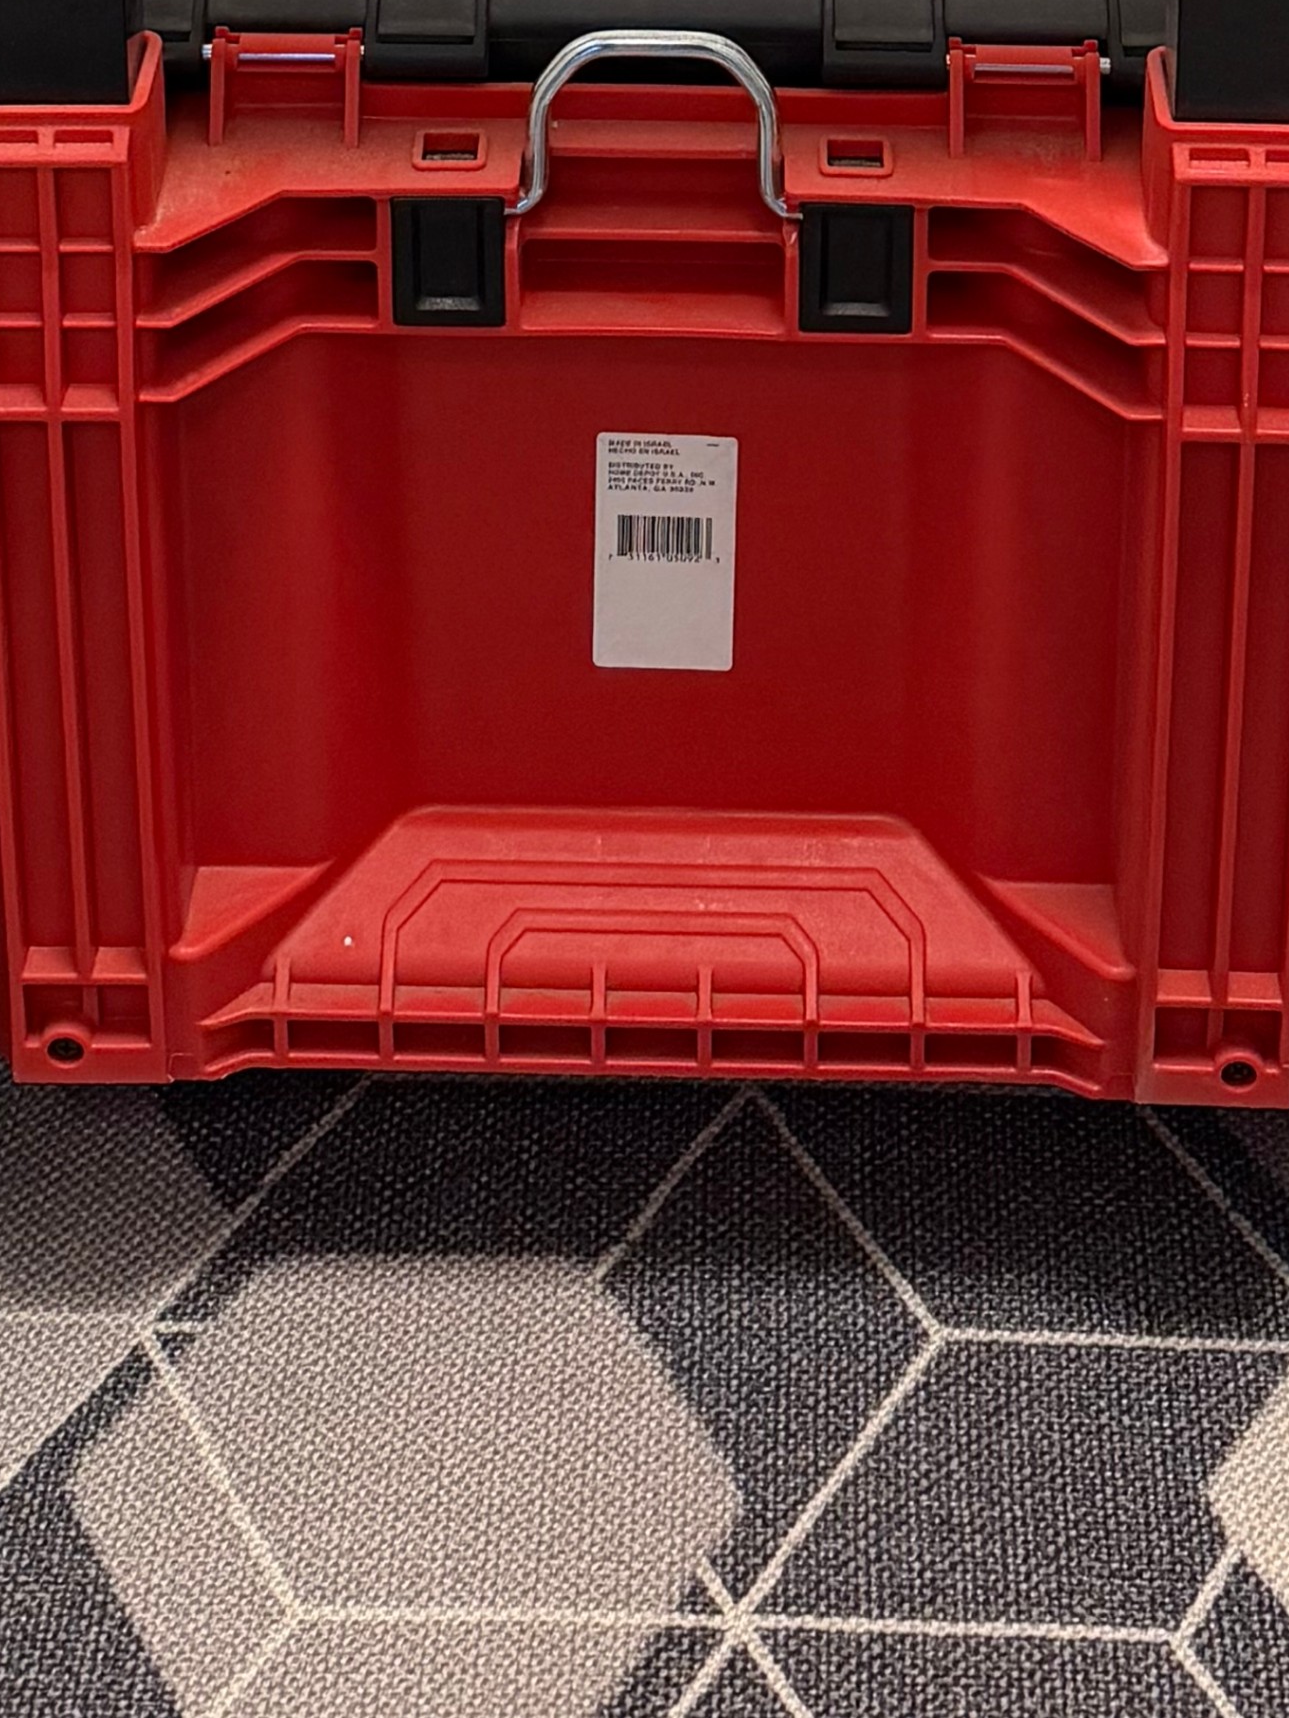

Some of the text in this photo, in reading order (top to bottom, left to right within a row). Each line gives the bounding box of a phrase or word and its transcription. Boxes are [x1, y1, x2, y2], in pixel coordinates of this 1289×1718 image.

[643, 439, 672, 449] ISRAEL
[608, 447, 637, 455] HECHO
[651, 448, 681, 456] ISRAEL
[608, 462, 661, 470] DISTRIBUTED
[633, 469, 660, 477] DEPOT
[653, 485, 666, 493] GA
